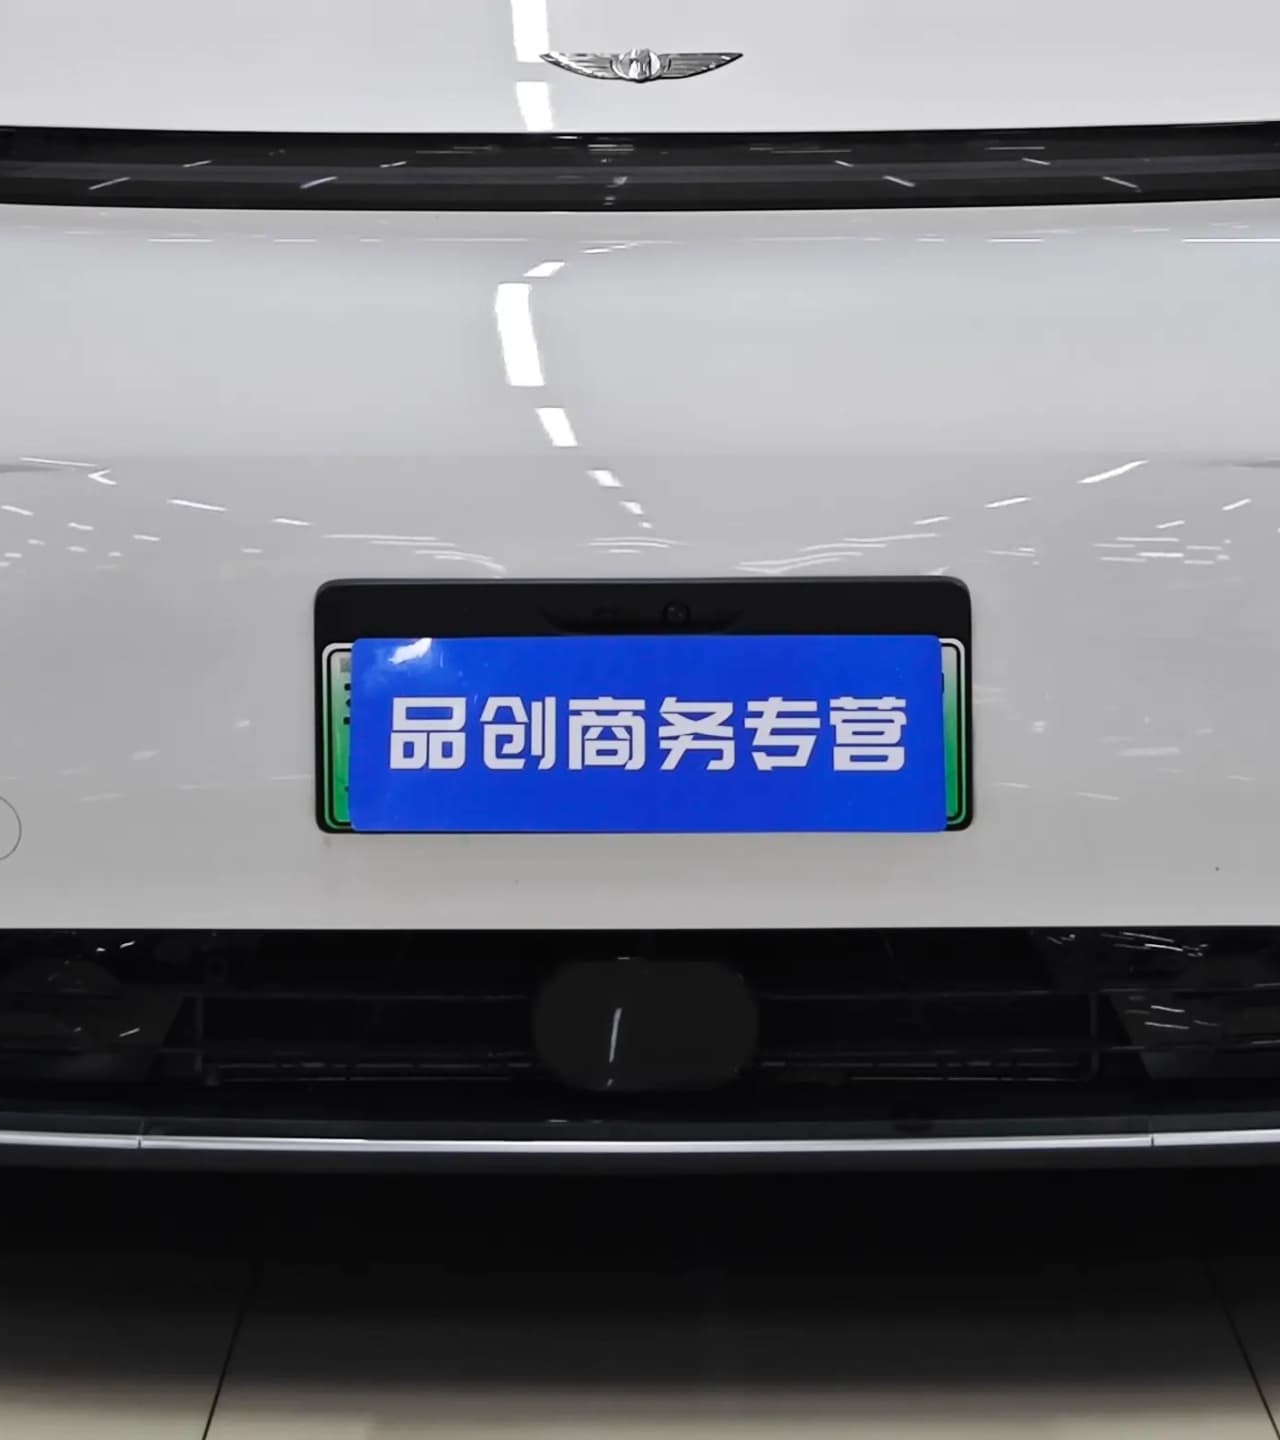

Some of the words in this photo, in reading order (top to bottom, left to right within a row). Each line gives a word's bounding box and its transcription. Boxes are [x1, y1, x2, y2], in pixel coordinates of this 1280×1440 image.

[388, 695, 908, 772] 品创商务专营
